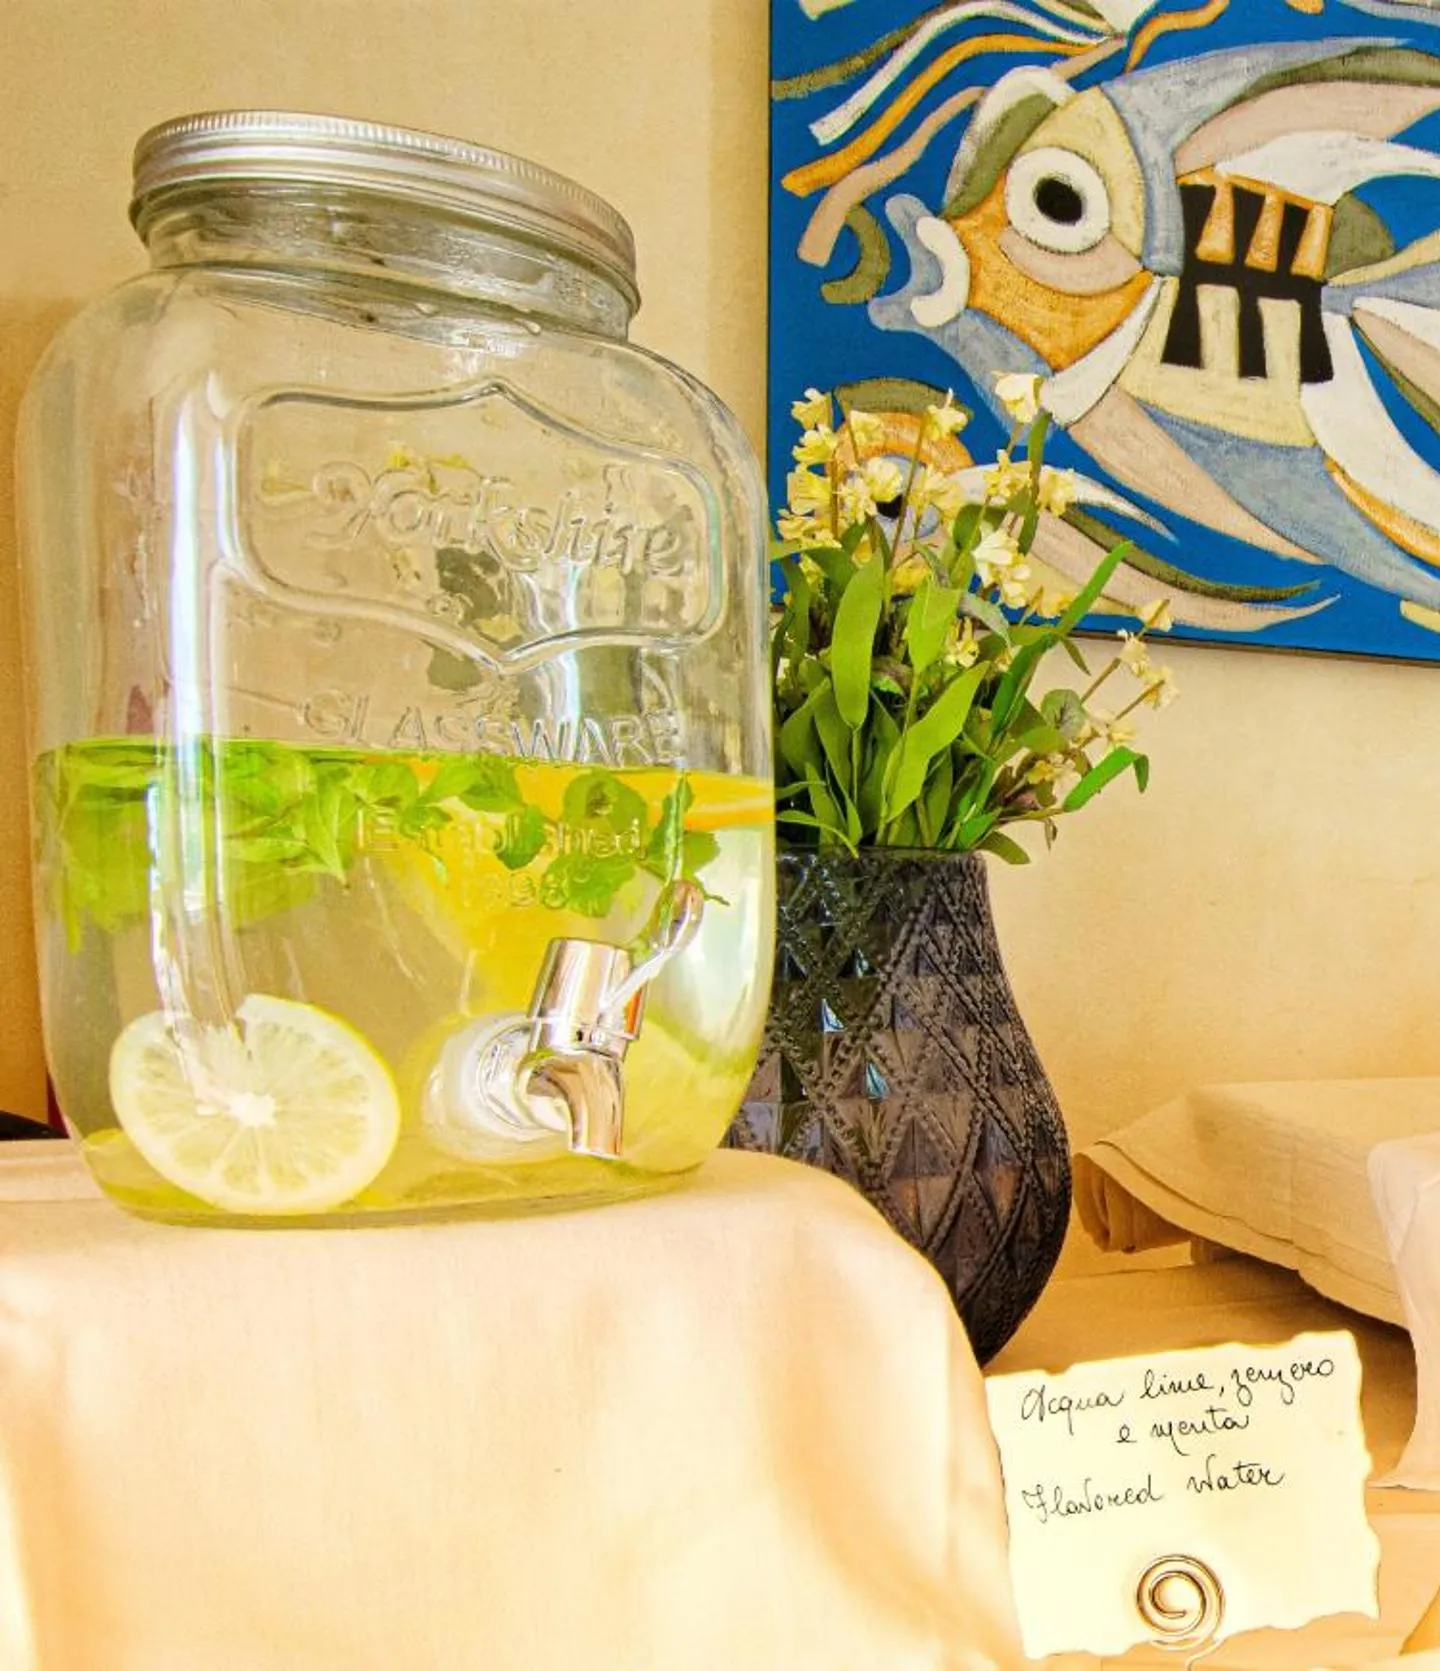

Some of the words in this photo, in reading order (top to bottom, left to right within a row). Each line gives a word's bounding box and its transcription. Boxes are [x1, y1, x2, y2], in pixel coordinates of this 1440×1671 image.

[302, 690, 685, 768] GLASSWARE
[1021, 1383, 1125, 1436] Acqua
[1140, 1369, 1226, 1397] lime,
[1231, 1357, 1336, 1407] zenzero
[1115, 1424, 1138, 1445] e
[1150, 1406, 1252, 1457] menta
[1021, 1472, 1166, 1525] Flavored
